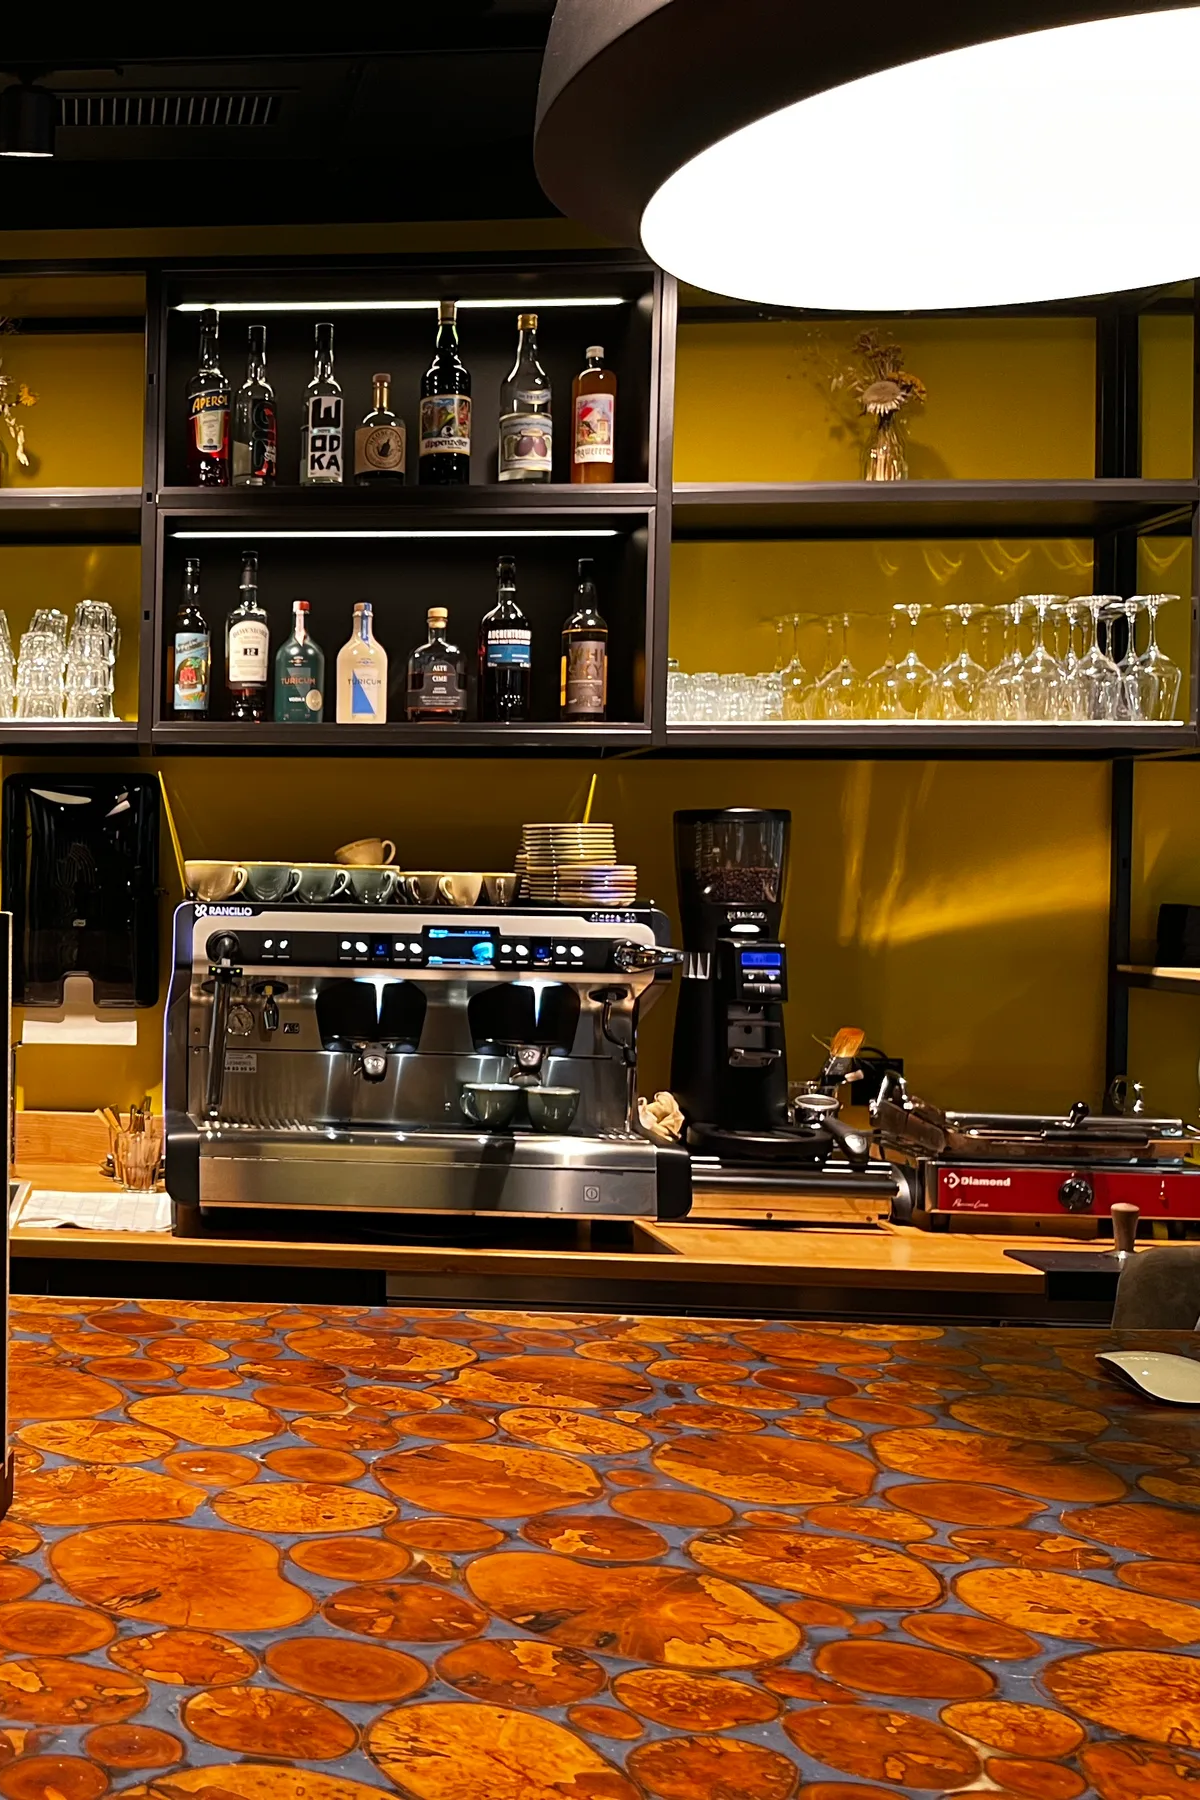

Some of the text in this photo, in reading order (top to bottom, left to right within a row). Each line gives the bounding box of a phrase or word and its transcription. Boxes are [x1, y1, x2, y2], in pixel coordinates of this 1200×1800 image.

[576, 447, 607, 459] ngwerer
[208, 906, 252, 916] RANCILIO
[960, 1176, 1011, 1187] Diamond
